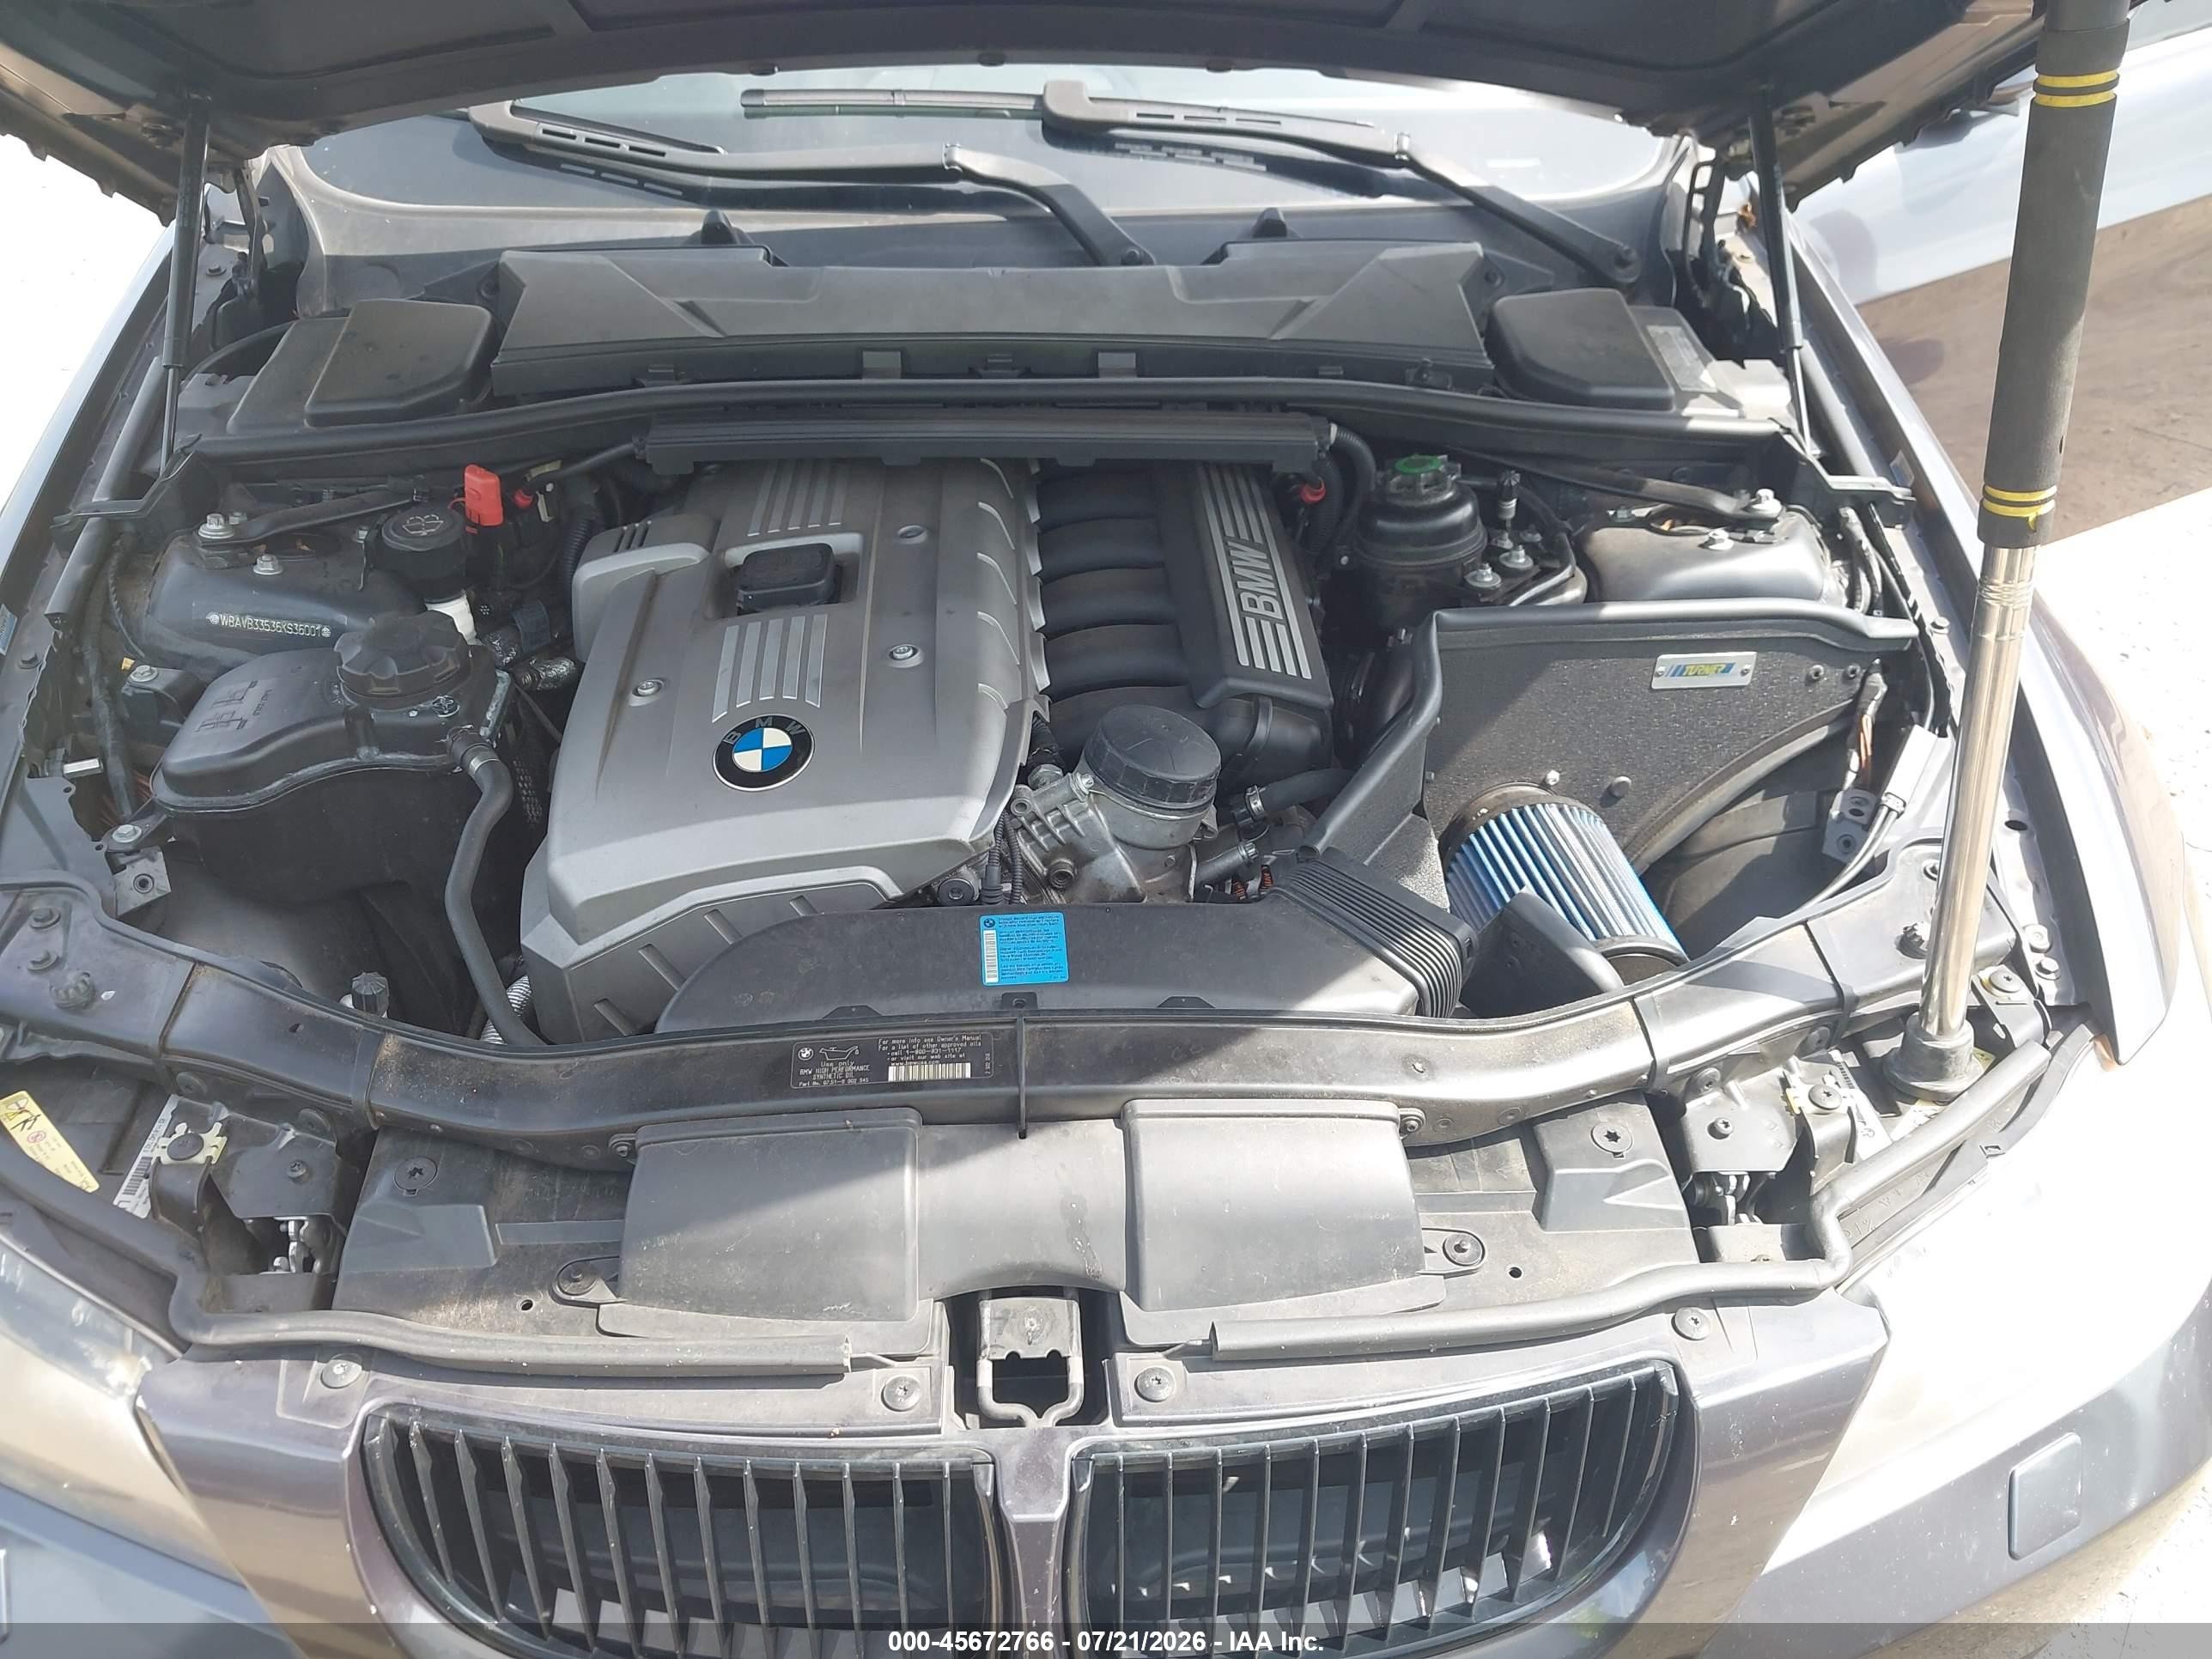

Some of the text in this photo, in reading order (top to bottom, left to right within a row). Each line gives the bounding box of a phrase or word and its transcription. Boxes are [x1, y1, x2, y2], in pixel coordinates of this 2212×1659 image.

[1226, 541, 1283, 619] BMW
[220, 614, 322, 637] WBAVB33536KS36001
[723, 716, 805, 744] BMW
[812, 1072, 844, 1080] SYNTHETIC
